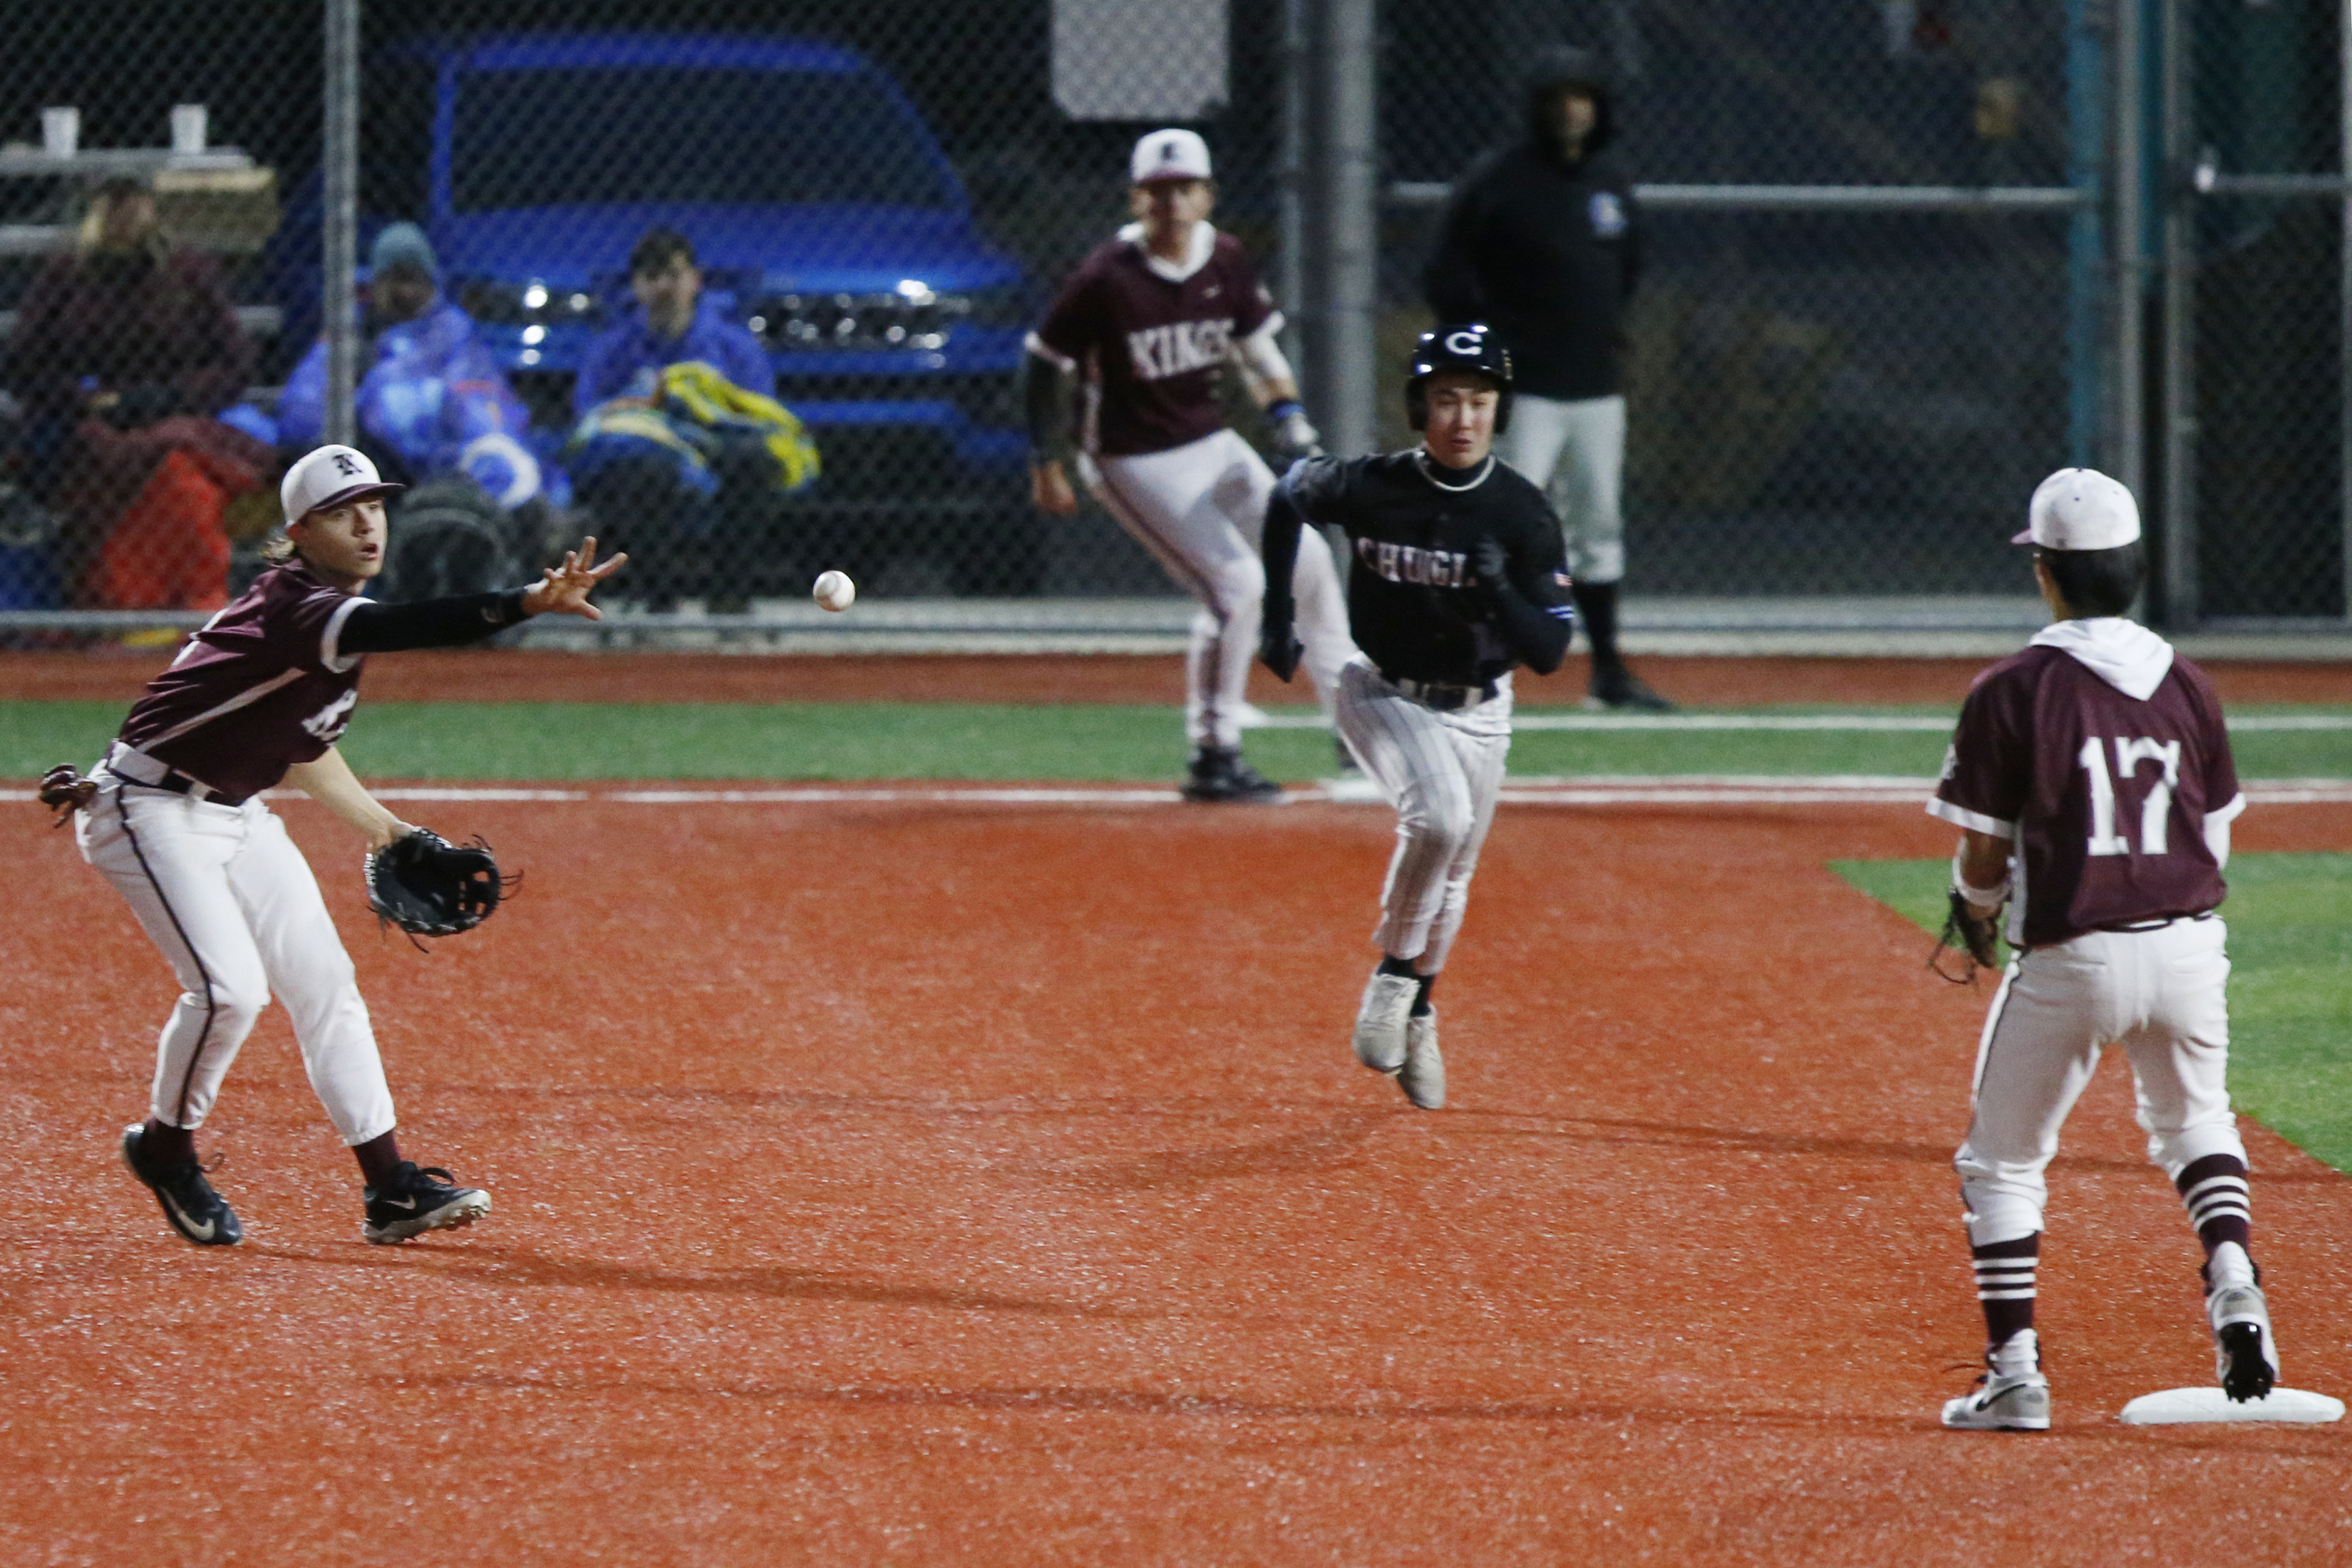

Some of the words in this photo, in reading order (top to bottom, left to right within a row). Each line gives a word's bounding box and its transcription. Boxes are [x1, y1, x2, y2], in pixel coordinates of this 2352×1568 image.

[1445, 331, 1483, 356] C
[1358, 537, 1477, 588] CHUGI
[2079, 736, 2181, 855] 17
